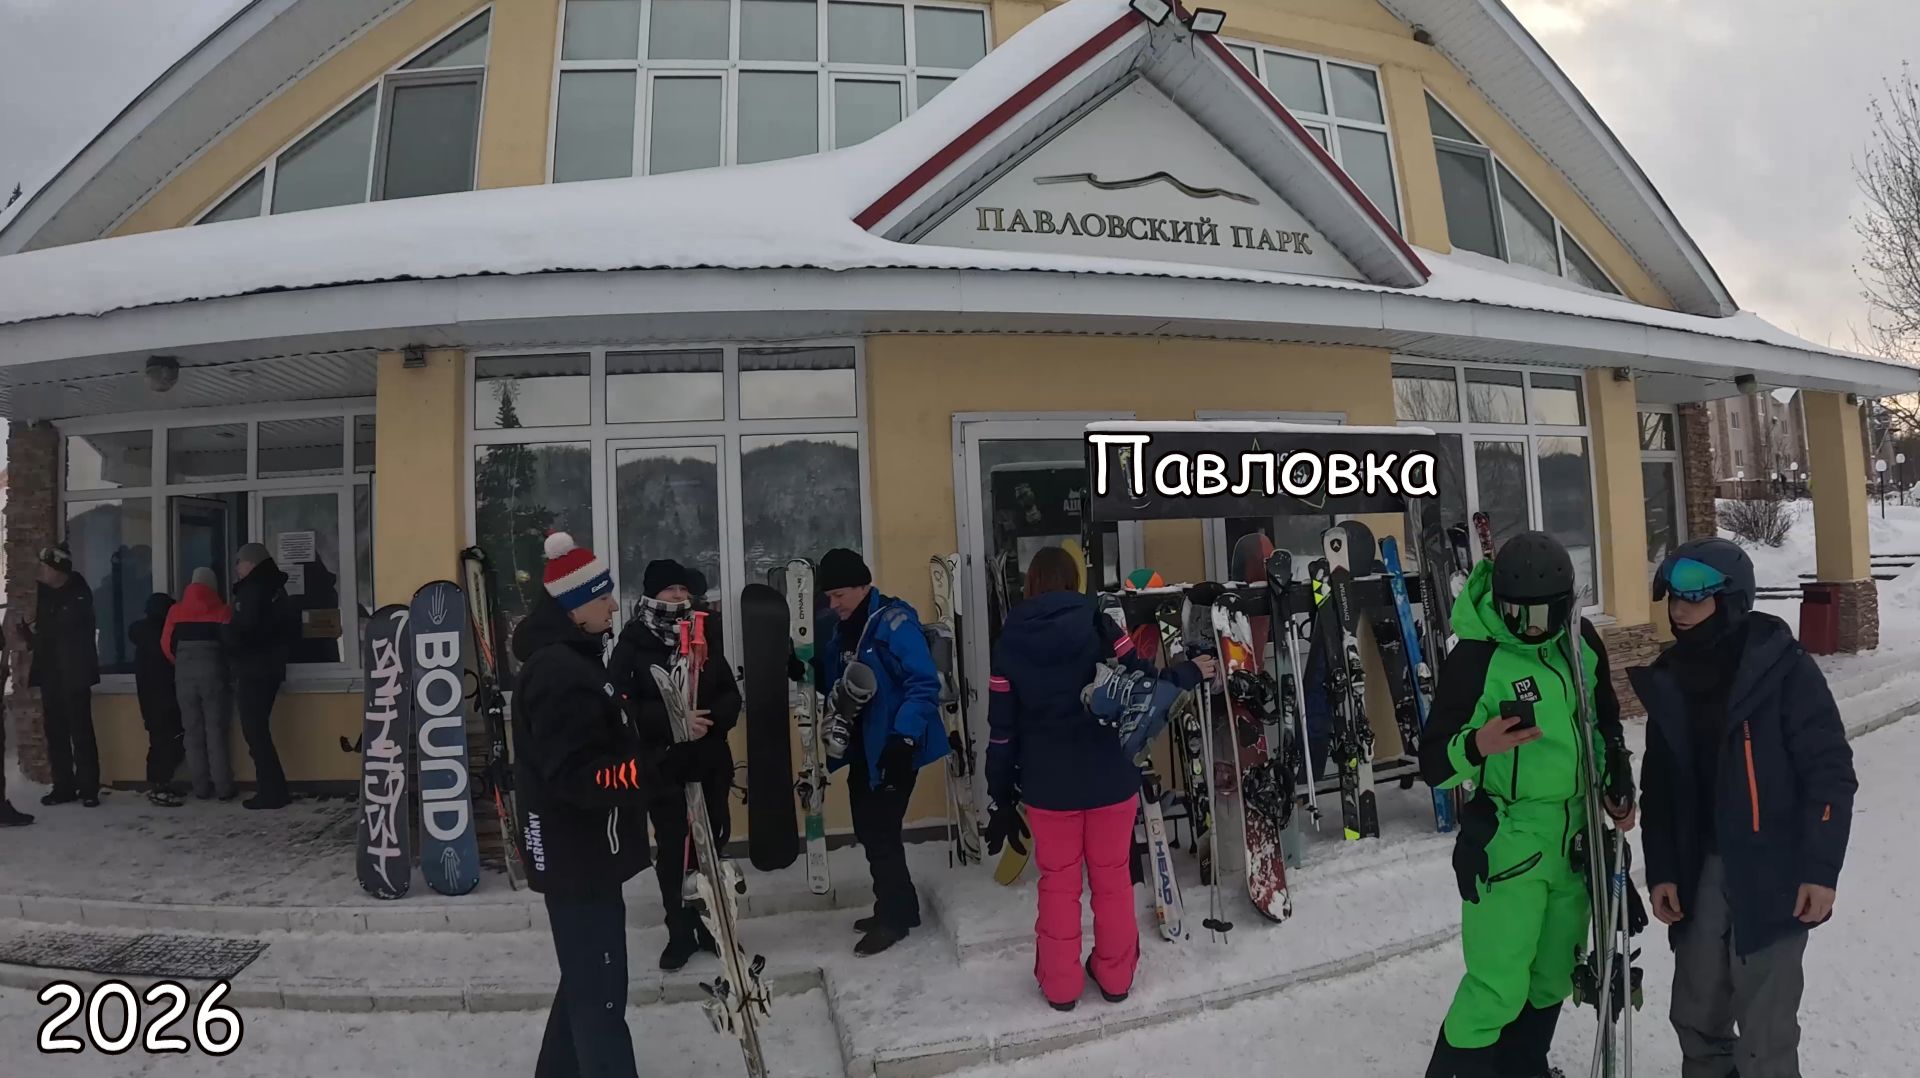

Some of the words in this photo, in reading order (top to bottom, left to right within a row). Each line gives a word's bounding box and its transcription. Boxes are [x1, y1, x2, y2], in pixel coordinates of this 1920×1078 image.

[976, 206, 1220, 246] ПАВЛОВСКИЙ
[1229, 224, 1313, 255] ПАРК
[416, 631, 468, 841] BOUND
[523, 826, 533, 851] TEAM
[528, 811, 545, 871] GERMANY
[1155, 841, 1173, 905] HEAD
